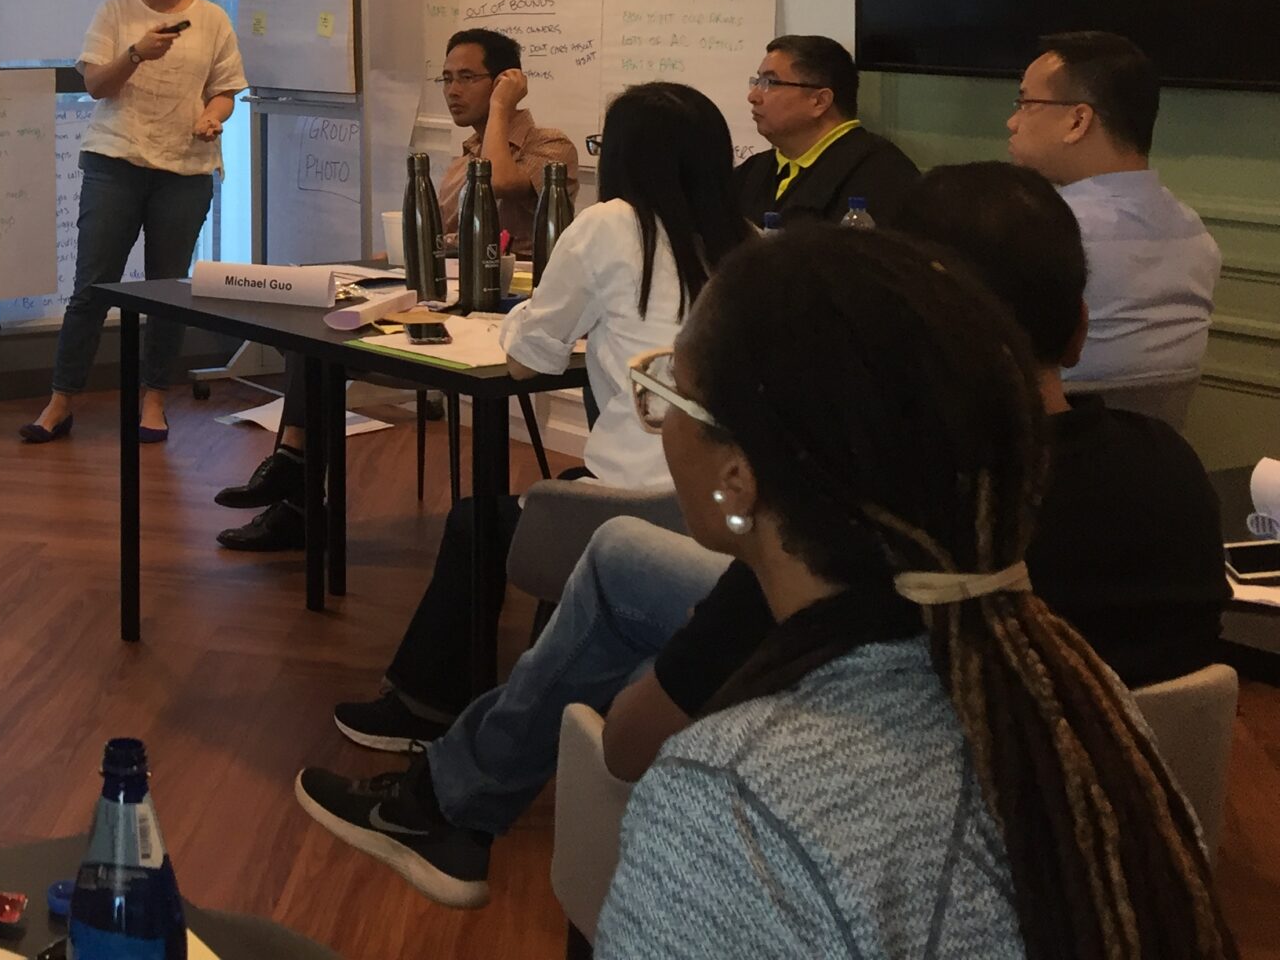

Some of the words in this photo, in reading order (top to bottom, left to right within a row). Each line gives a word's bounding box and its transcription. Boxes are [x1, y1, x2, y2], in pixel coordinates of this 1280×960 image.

[466, 5, 487, 18] OUT
[490, 0, 506, 14] OF
[309, 117, 360, 142] GROUP
[306, 153, 350, 182] PHOTO
[225, 275, 267, 289] Michael
[270, 278, 293, 291] Guo
